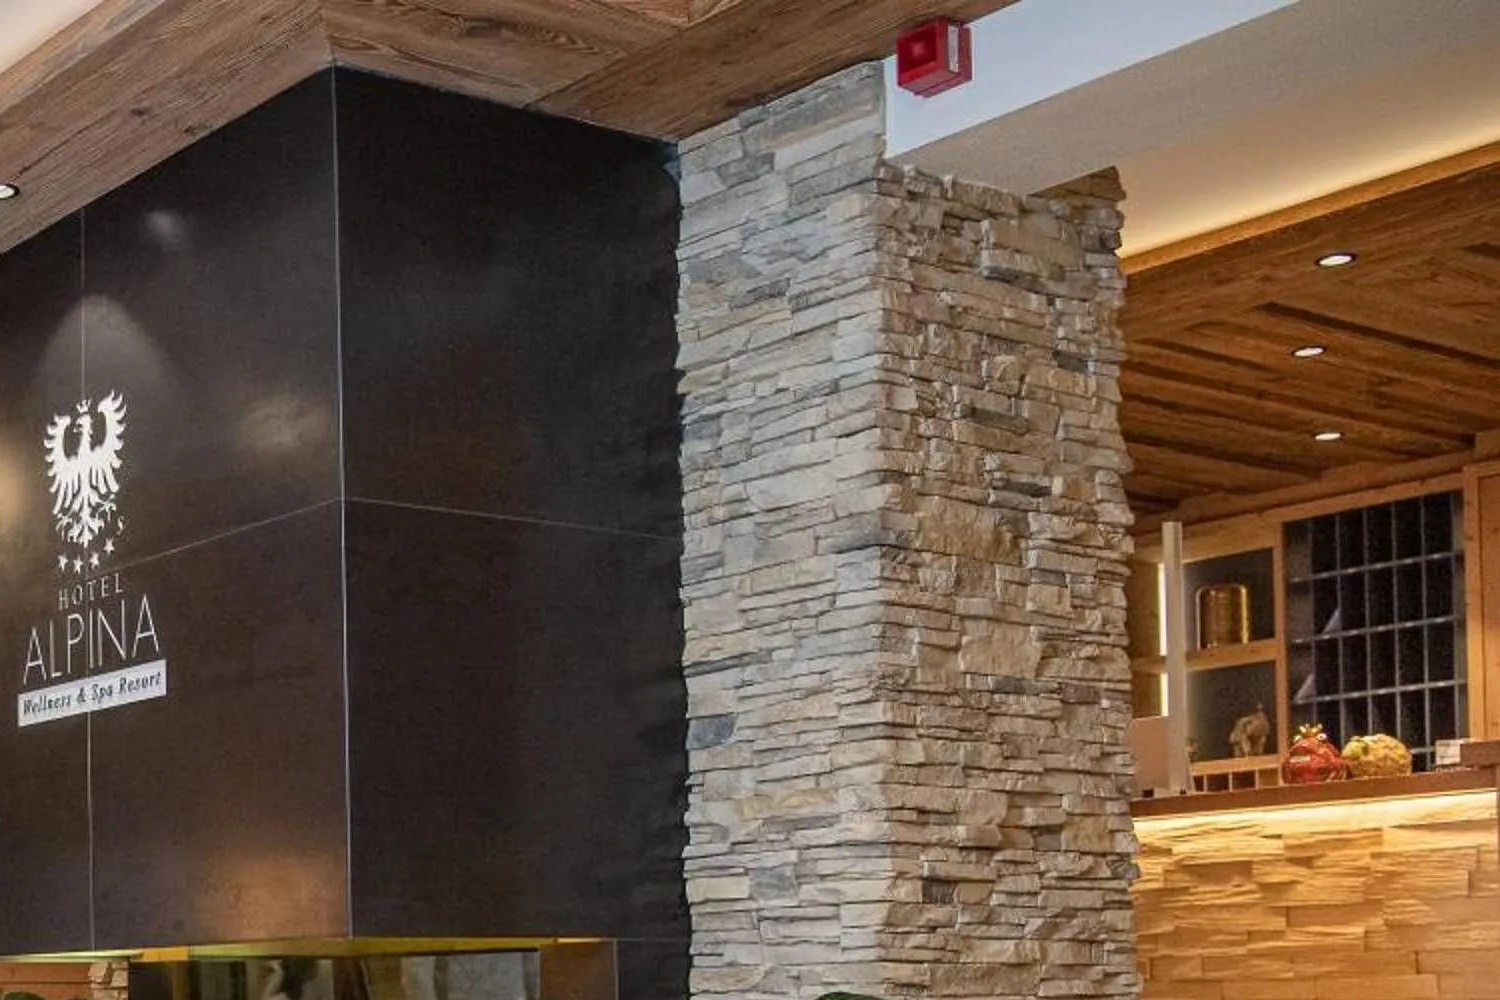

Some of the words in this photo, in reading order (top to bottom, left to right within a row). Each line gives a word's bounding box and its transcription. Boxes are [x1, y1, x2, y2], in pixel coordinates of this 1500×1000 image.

[59, 572, 124, 610] HOTEL
[23, 593, 161, 684] ALPINA
[23, 694, 71, 716] Wellness
[76, 687, 86, 704] &
[91, 683, 113, 704] Spa
[118, 671, 162, 695] Resort
